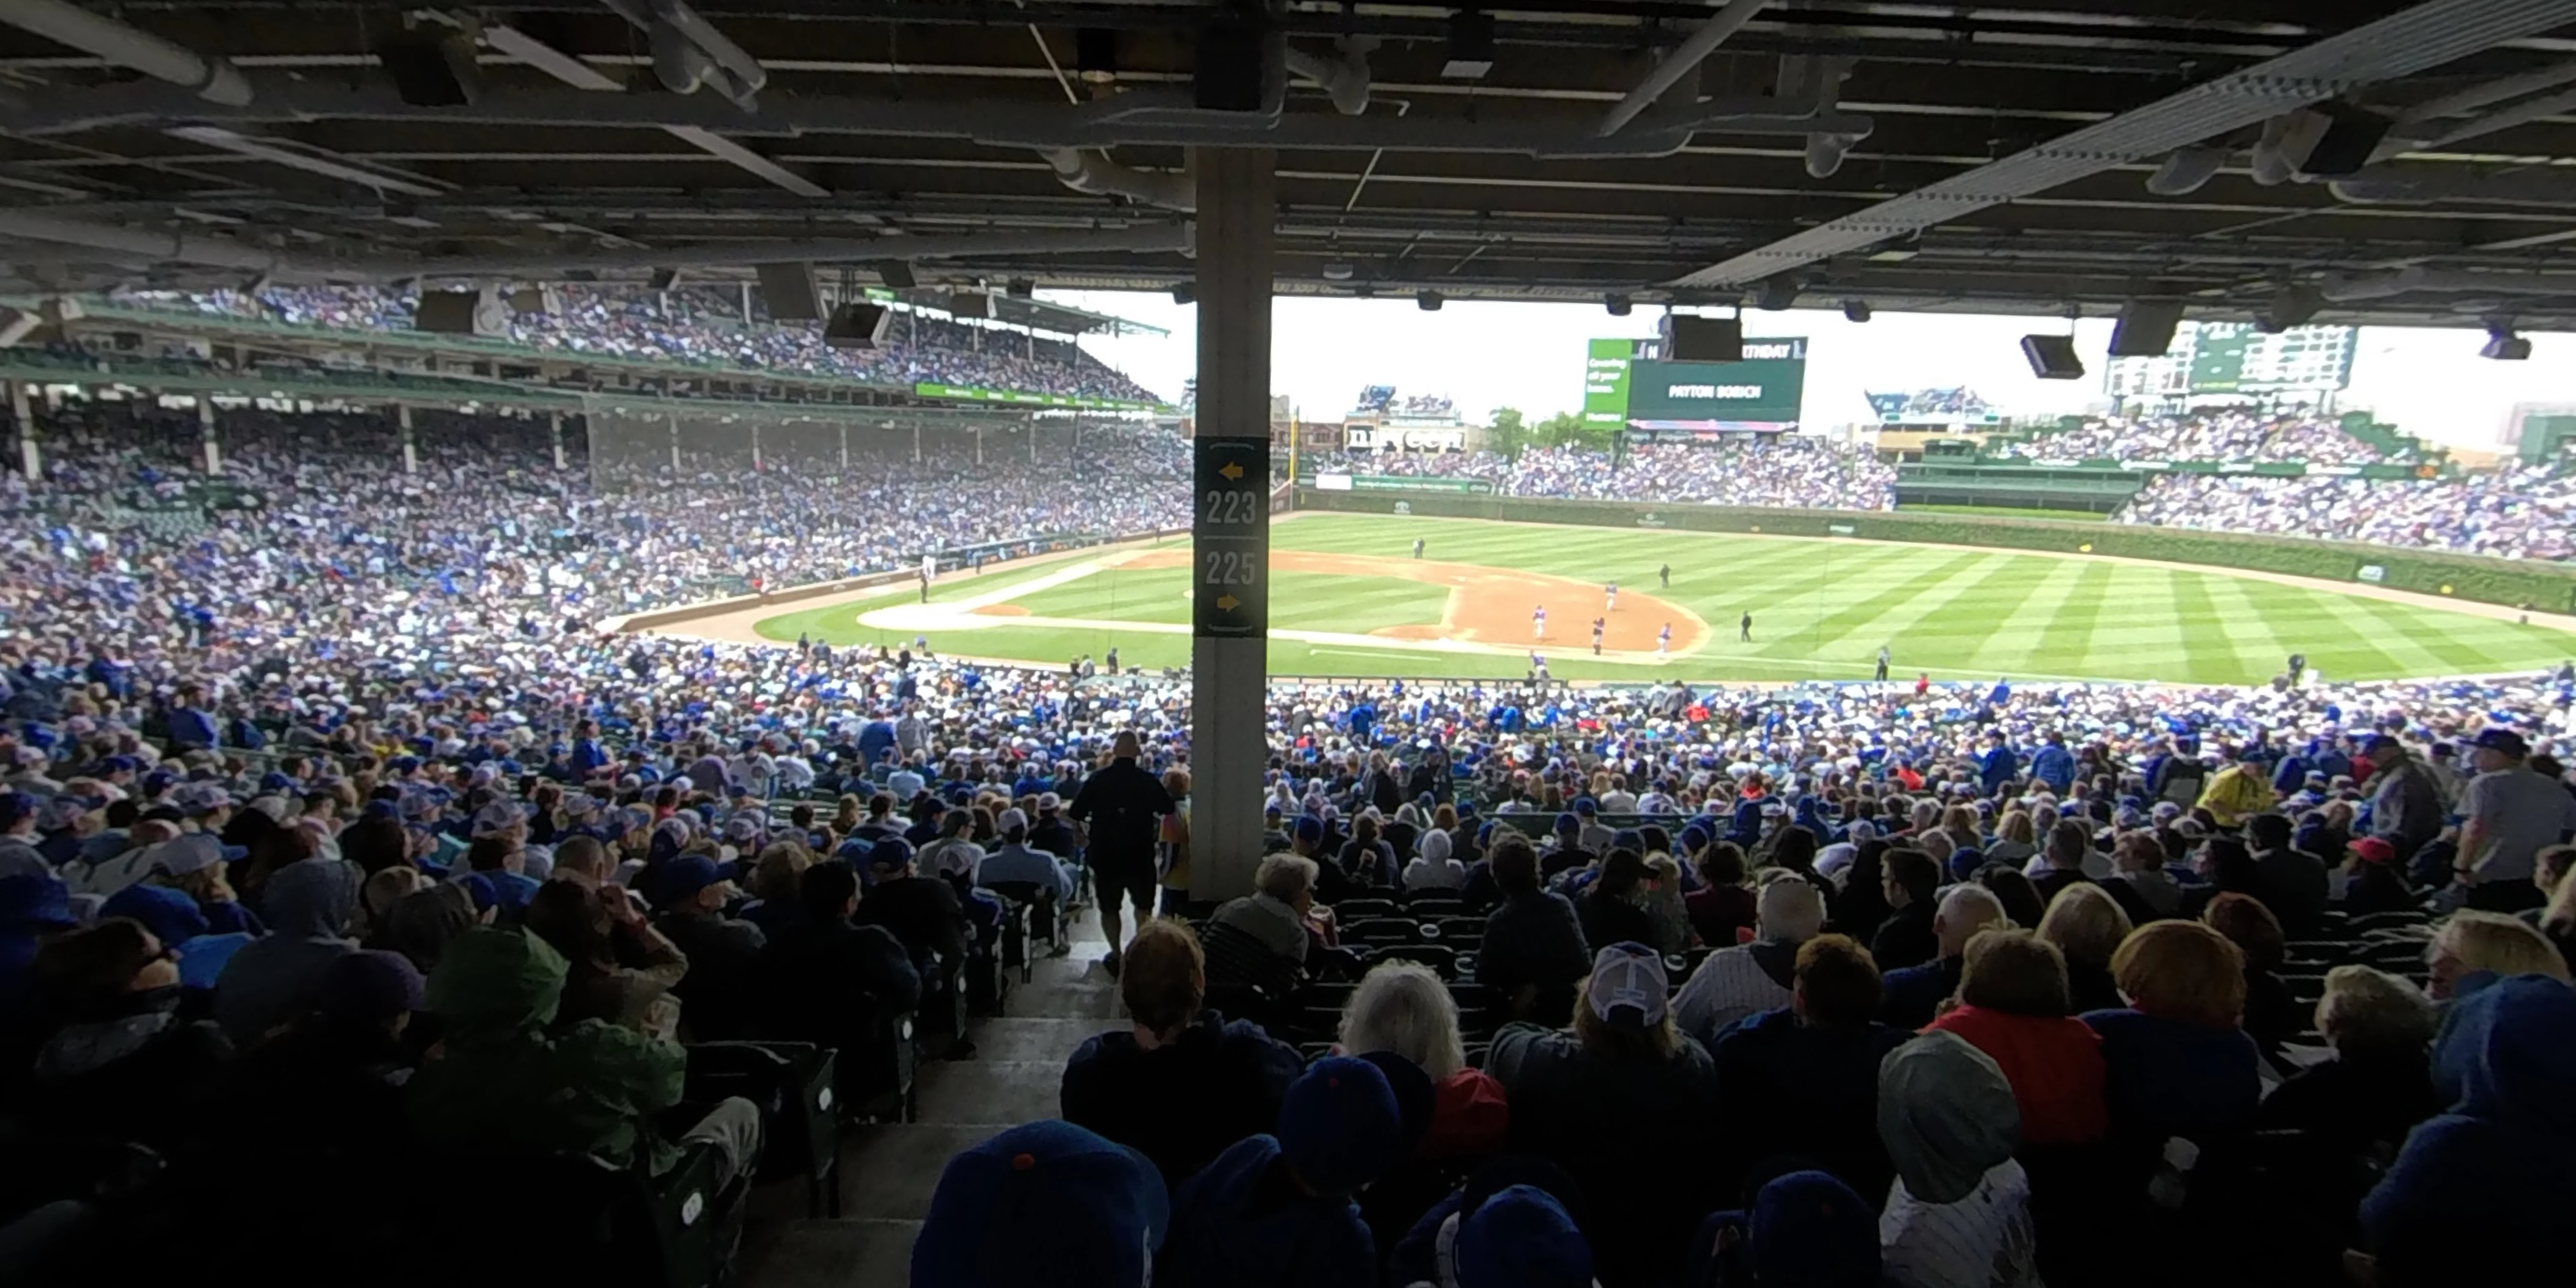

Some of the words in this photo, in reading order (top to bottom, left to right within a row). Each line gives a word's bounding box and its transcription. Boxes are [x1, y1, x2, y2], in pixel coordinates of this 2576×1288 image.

[1669, 385, 1715, 398] PAYTON
[1206, 490, 1257, 524] 223
[1206, 551, 1255, 585] 225
